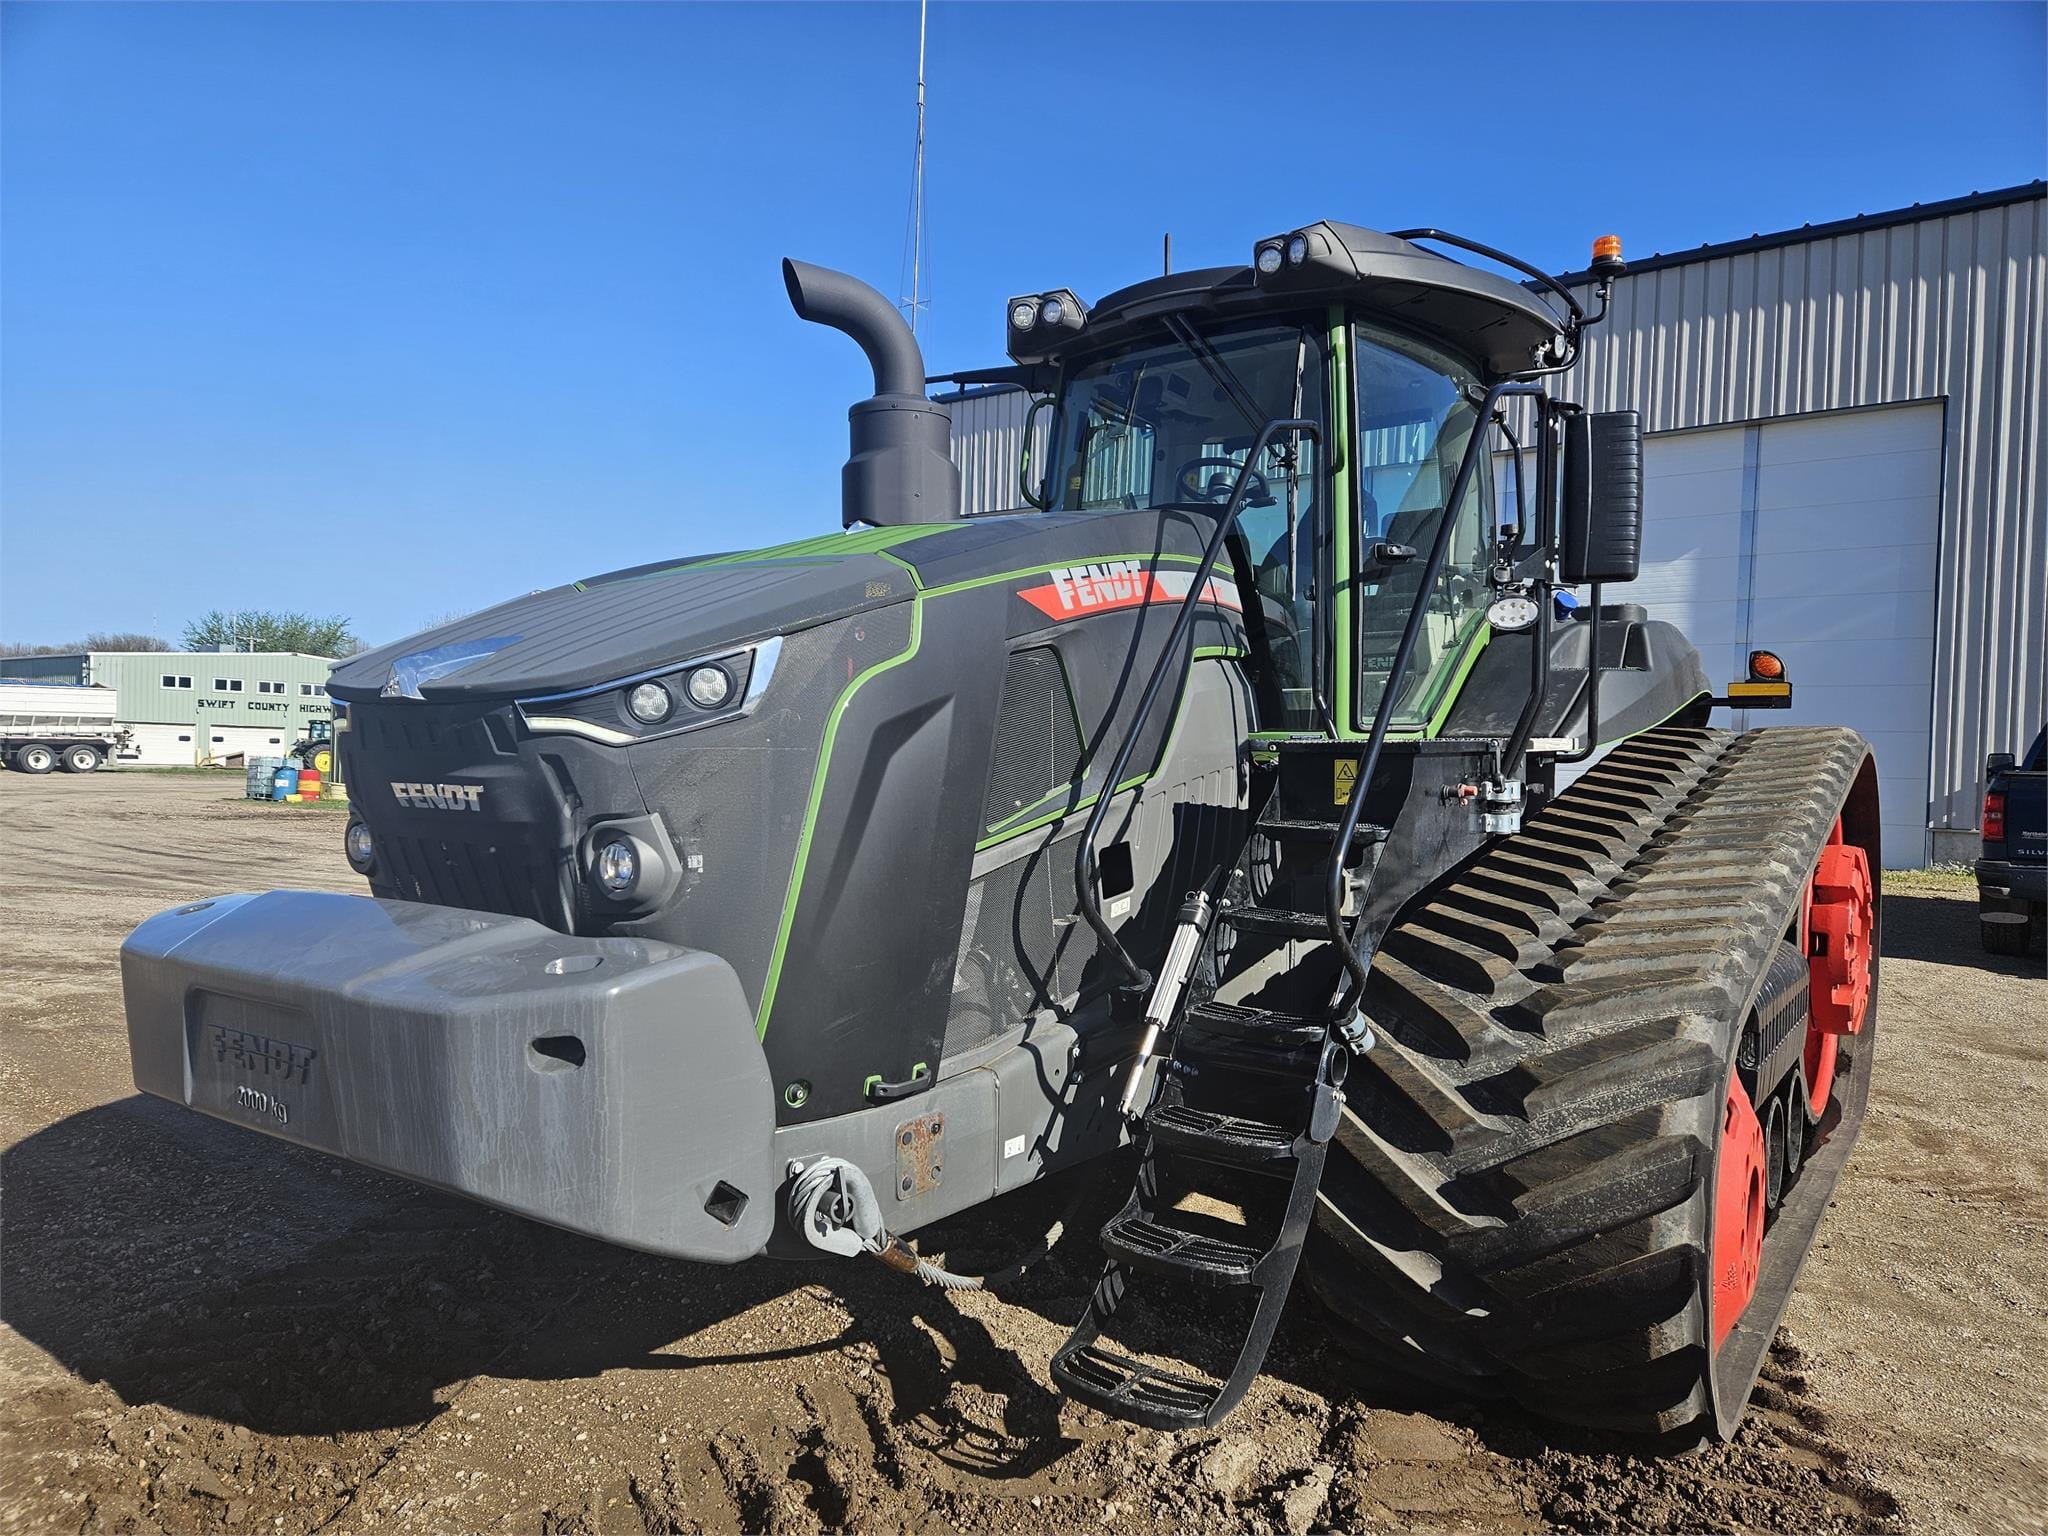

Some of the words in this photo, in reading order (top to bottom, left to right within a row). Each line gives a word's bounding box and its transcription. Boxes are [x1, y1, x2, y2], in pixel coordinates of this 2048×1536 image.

[1050, 560, 1143, 611] FENDT
[198, 699, 235, 709] SWIFT
[247, 701, 289, 711] COUNTY
[390, 782, 484, 812] FENDT
[207, 1023, 317, 1084] FENDT
[237, 1085, 267, 1113] 2000
[271, 1095, 288, 1124] kg
